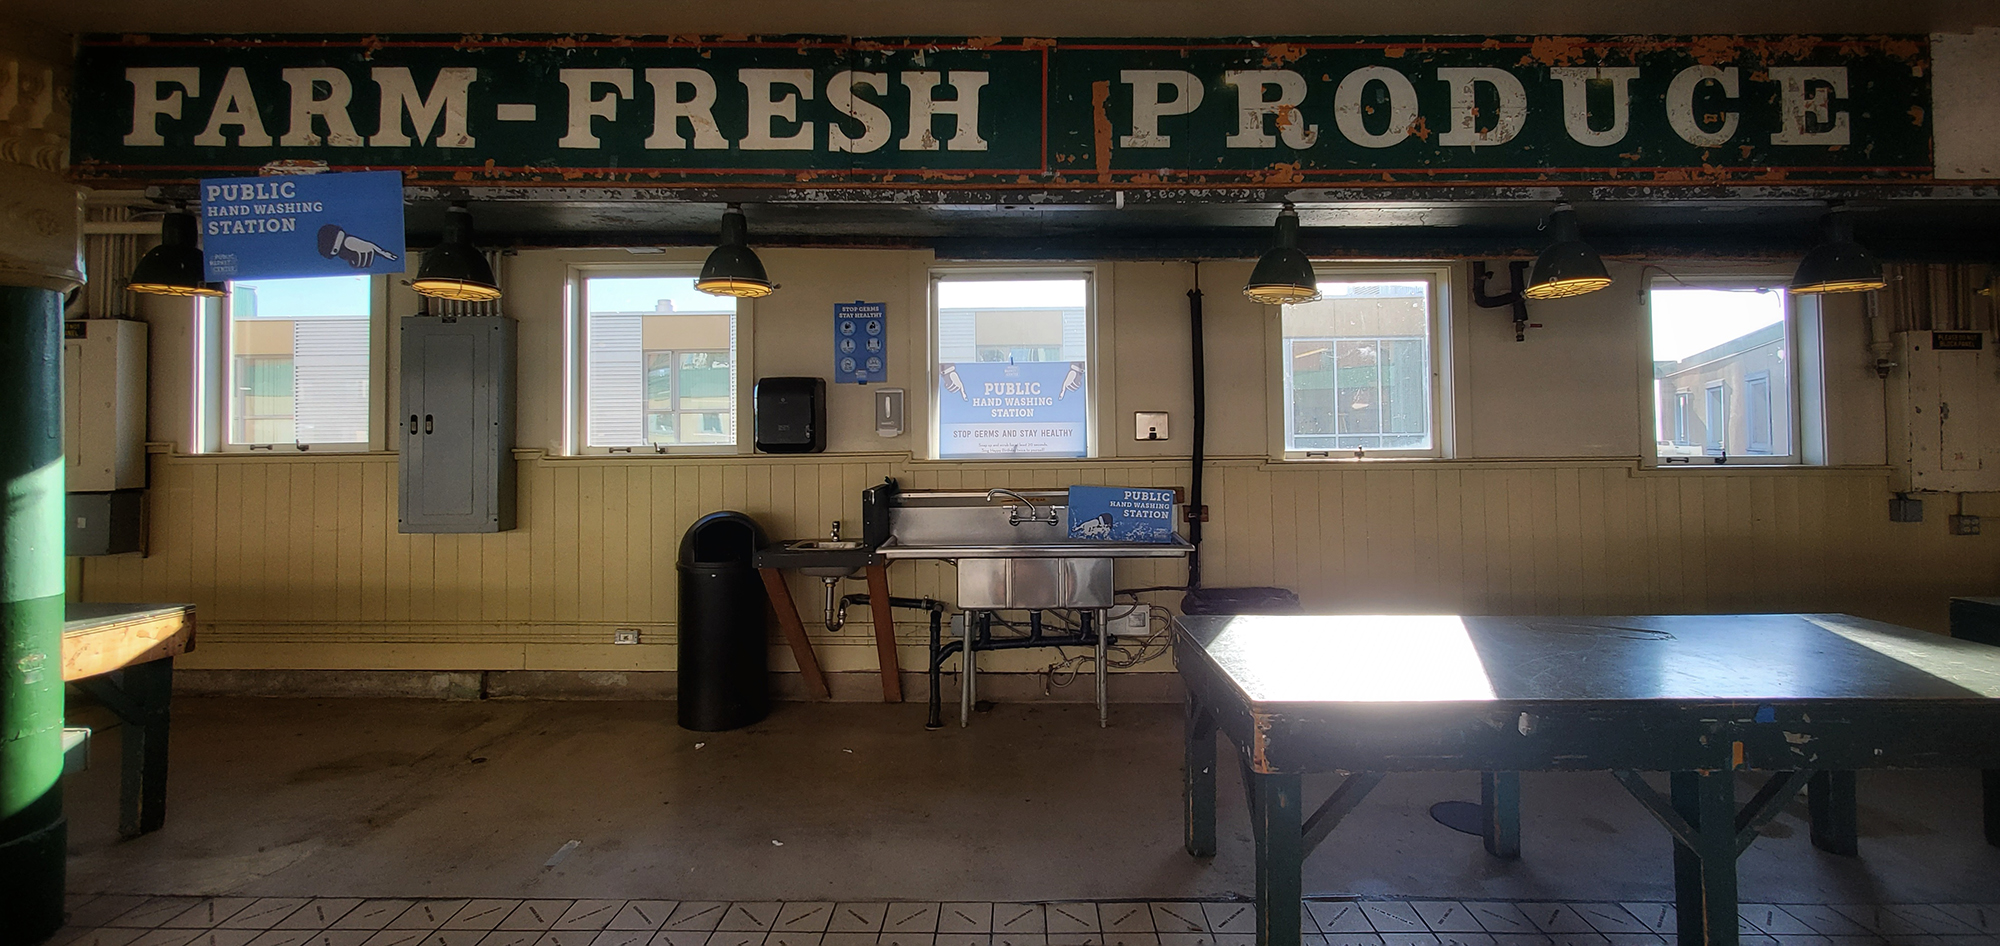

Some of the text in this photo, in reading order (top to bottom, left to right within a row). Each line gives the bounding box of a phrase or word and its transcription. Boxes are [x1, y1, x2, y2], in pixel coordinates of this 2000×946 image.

[1119, 64, 1850, 150] PRODUCE
[207, 182, 296, 202] PUBLIC
[208, 202, 323, 216] HAND WASHING
[208, 218, 296, 235] STATION
[984, 382, 1041, 396] PUBLIC
[972, 396, 1053, 407] HAND WASHING
[990, 408, 1034, 418] STATION
[953, 430, 972, 438] STOP
[974, 430, 1000, 438] GERMS
[1020, 430, 1038, 438] STAY
[1041, 429, 1074, 437] HEALTHY
[1124, 490, 1170, 502] PUBLIC
[1123, 510, 1170, 519] STATION
